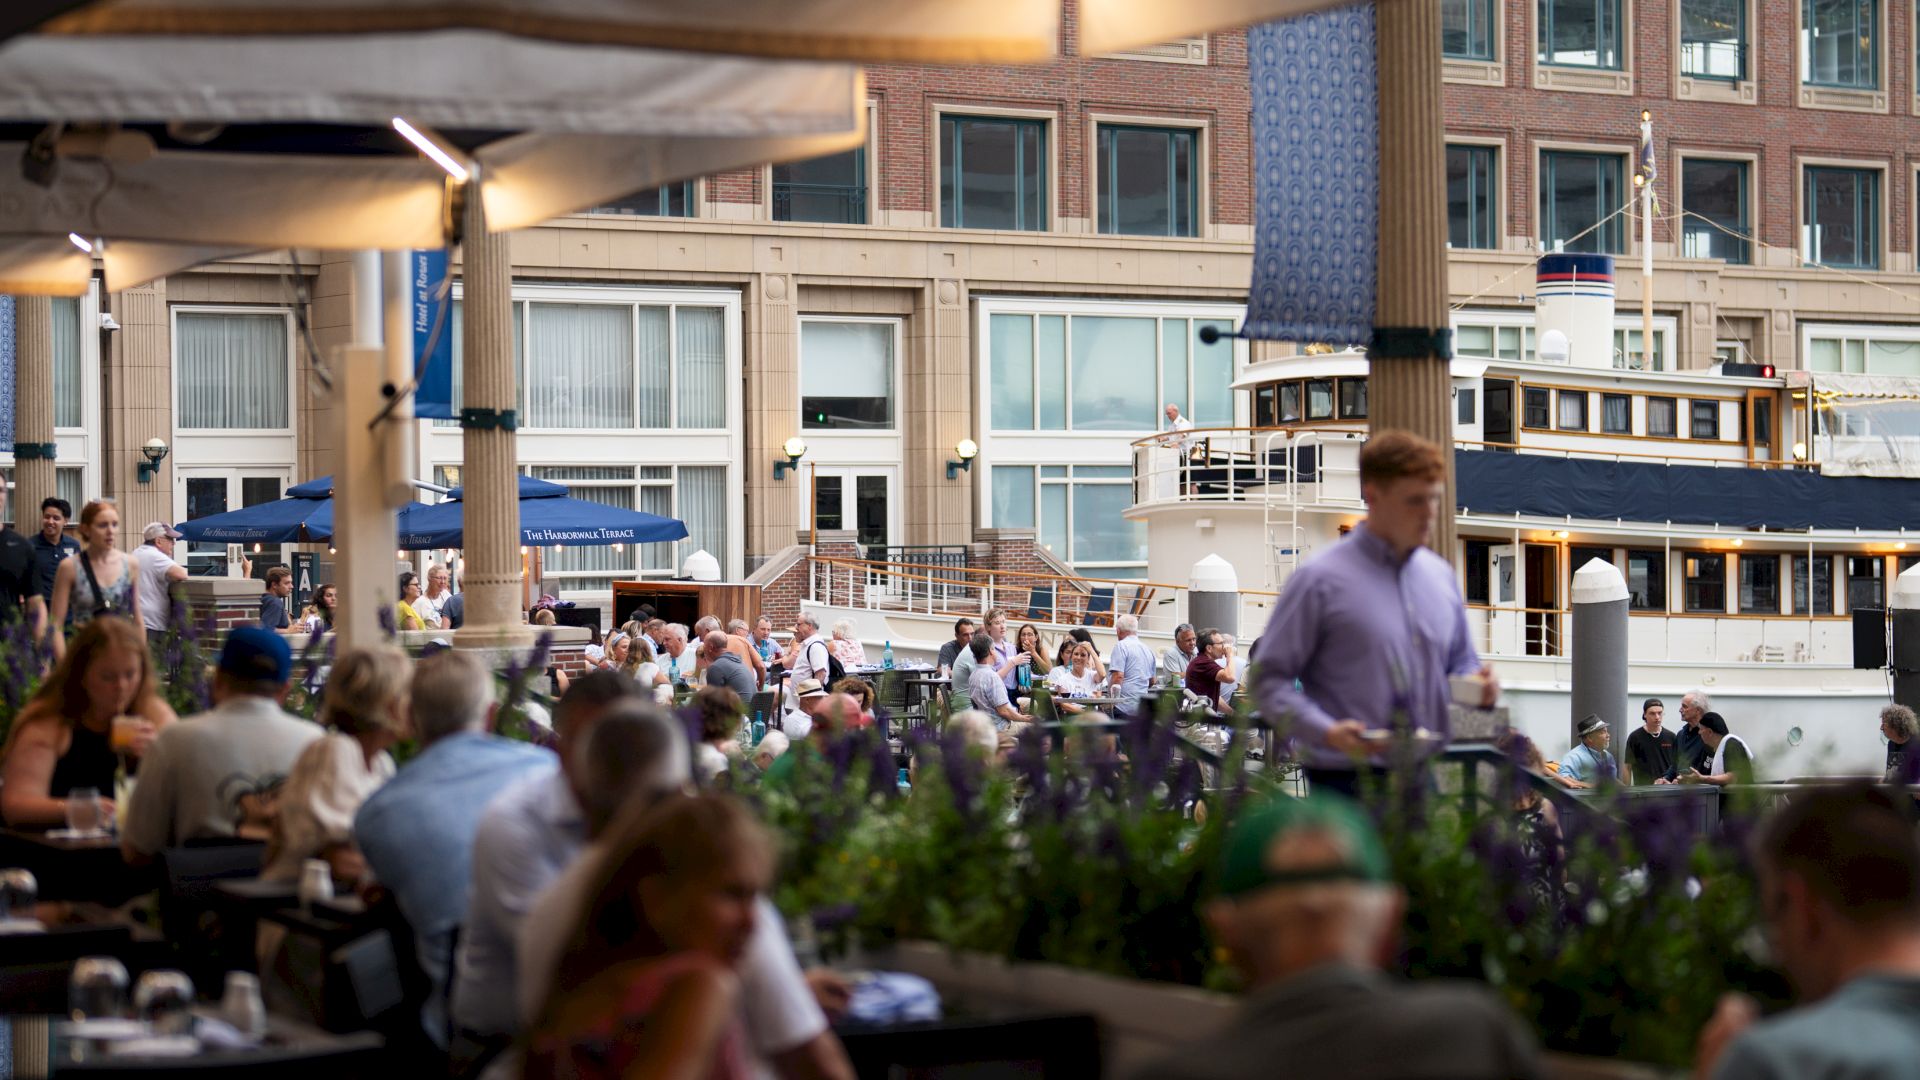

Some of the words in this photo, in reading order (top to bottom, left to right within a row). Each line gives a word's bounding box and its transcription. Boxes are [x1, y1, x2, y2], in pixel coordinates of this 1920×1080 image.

[416, 302, 428, 333] Hotel
[524, 530, 543, 540] THE
[543, 529, 600, 540] HARBORWALK
[599, 528, 635, 539] TERRACE
[299, 568, 312, 592] A
